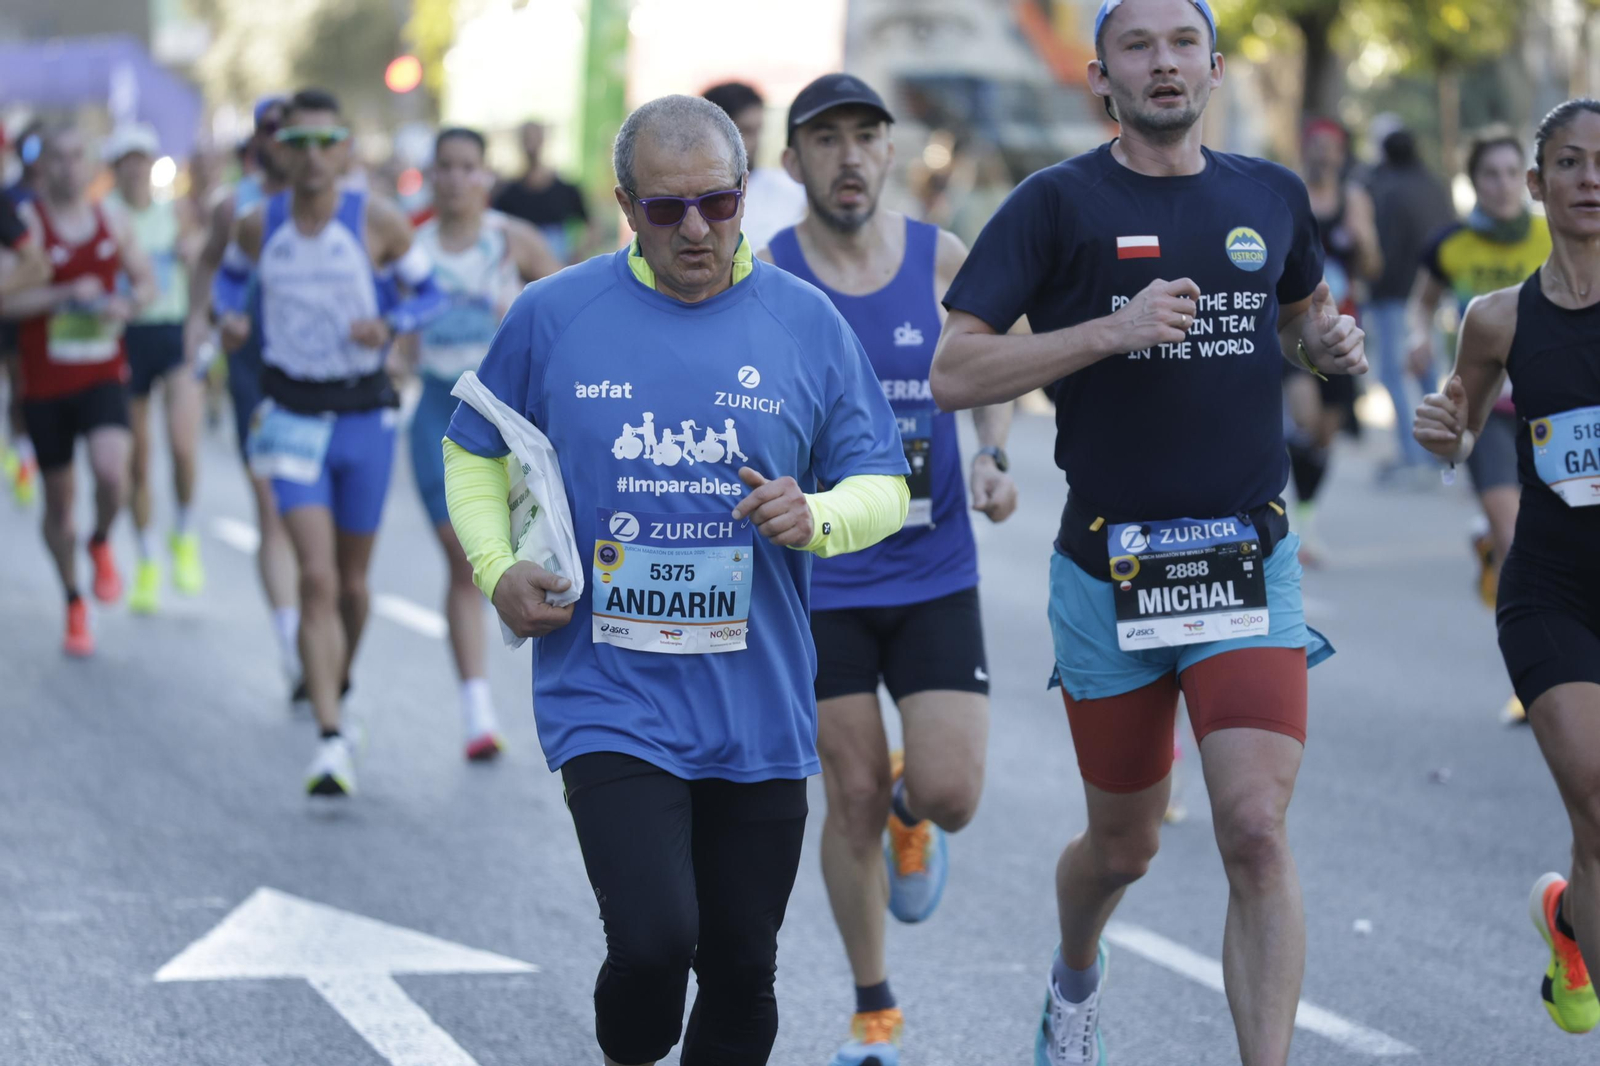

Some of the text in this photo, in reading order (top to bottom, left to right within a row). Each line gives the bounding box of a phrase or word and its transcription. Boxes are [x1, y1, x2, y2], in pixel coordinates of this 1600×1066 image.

[1199, 292, 1228, 311] THE
[1234, 291, 1268, 309] BEST
[1158, 341, 1192, 359] THE
[1197, 337, 1255, 358] WORLD
[576, 380, 633, 399] aefat
[714, 391, 781, 415] ZURICH
[1565, 447, 1600, 474] GA
[616, 476, 742, 497] #Imparables
[649, 521, 733, 540] ZURICH
[1160, 521, 1238, 544] ZURICH
[649, 563, 695, 582] 5375
[1165, 560, 1209, 579] 2888
[606, 585, 736, 618] ANDARÍN
[1137, 580, 1244, 615] MICHAL
